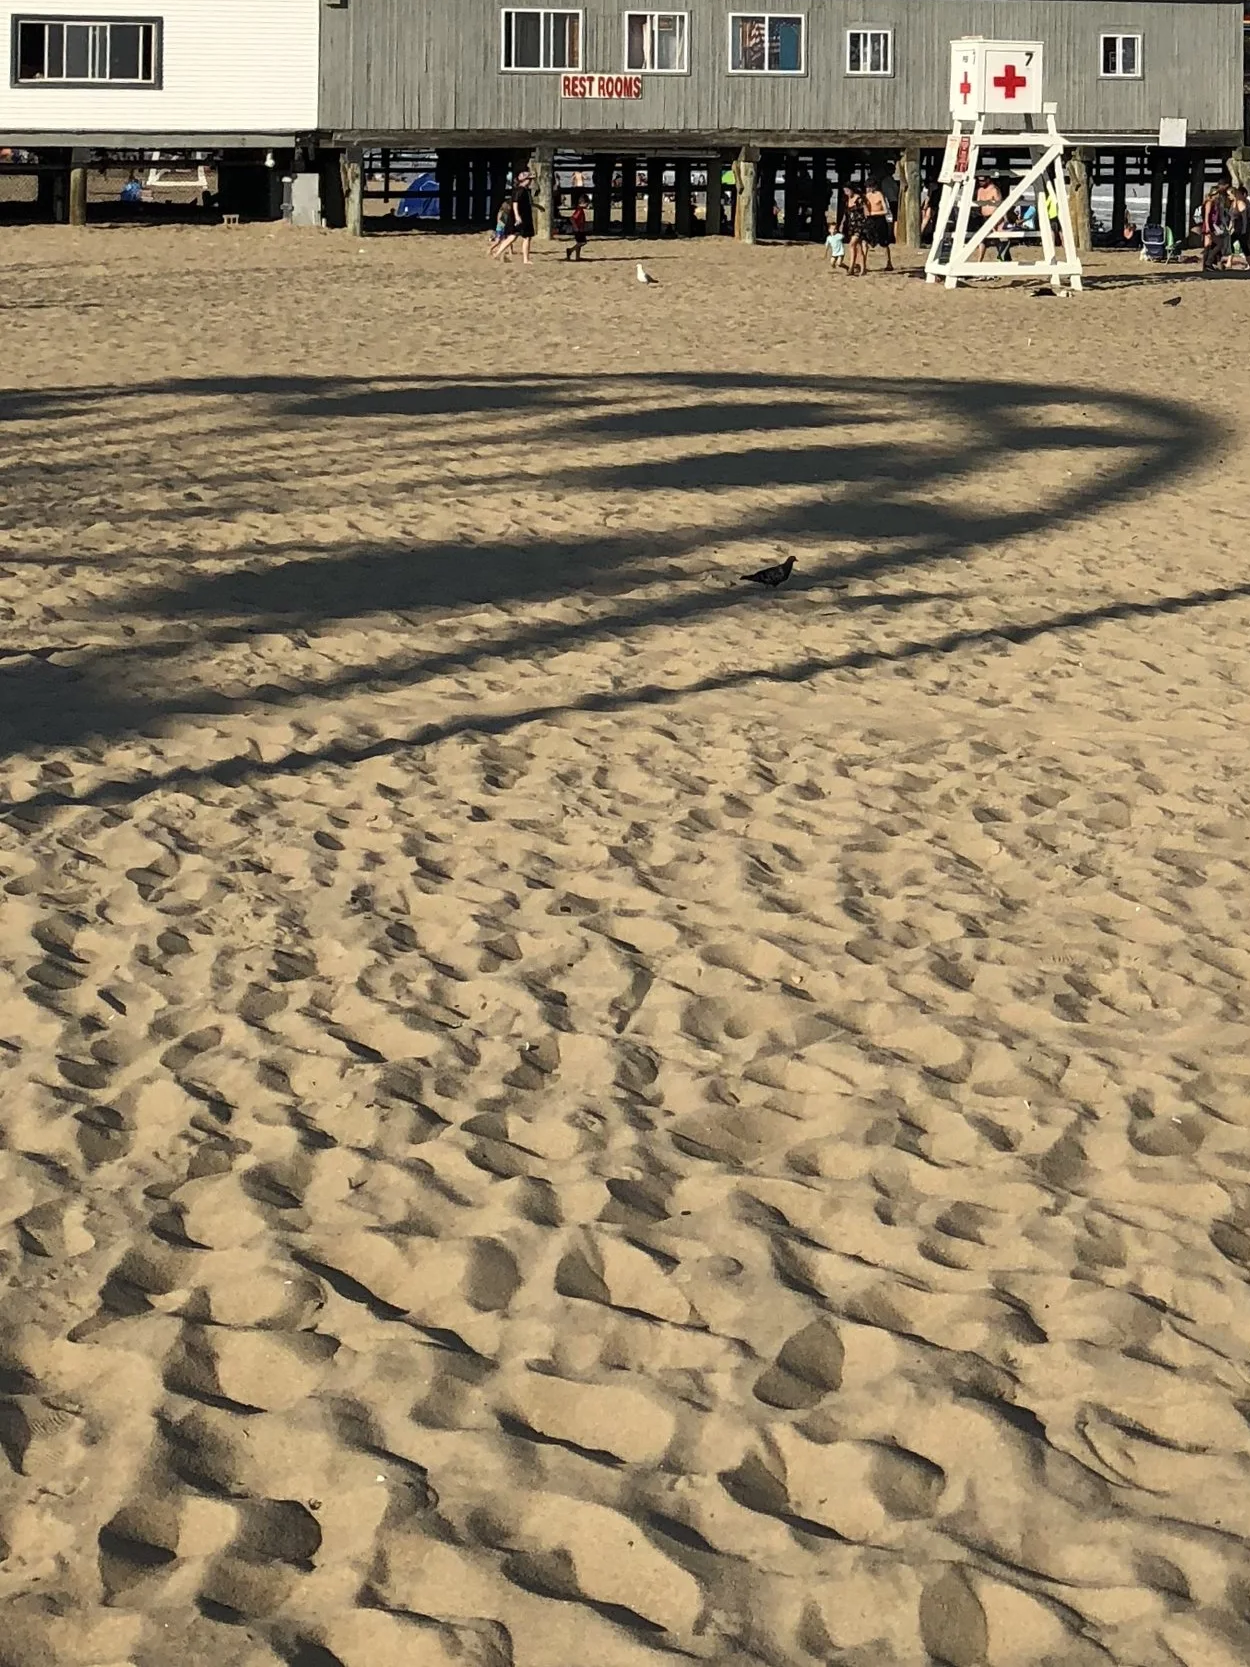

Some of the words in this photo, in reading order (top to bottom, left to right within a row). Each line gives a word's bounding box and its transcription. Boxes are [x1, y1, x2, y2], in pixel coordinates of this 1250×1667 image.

[1025, 52, 1034, 67] 7
[563, 75, 595, 98] REST
[598, 76, 642, 98] ROOMS
